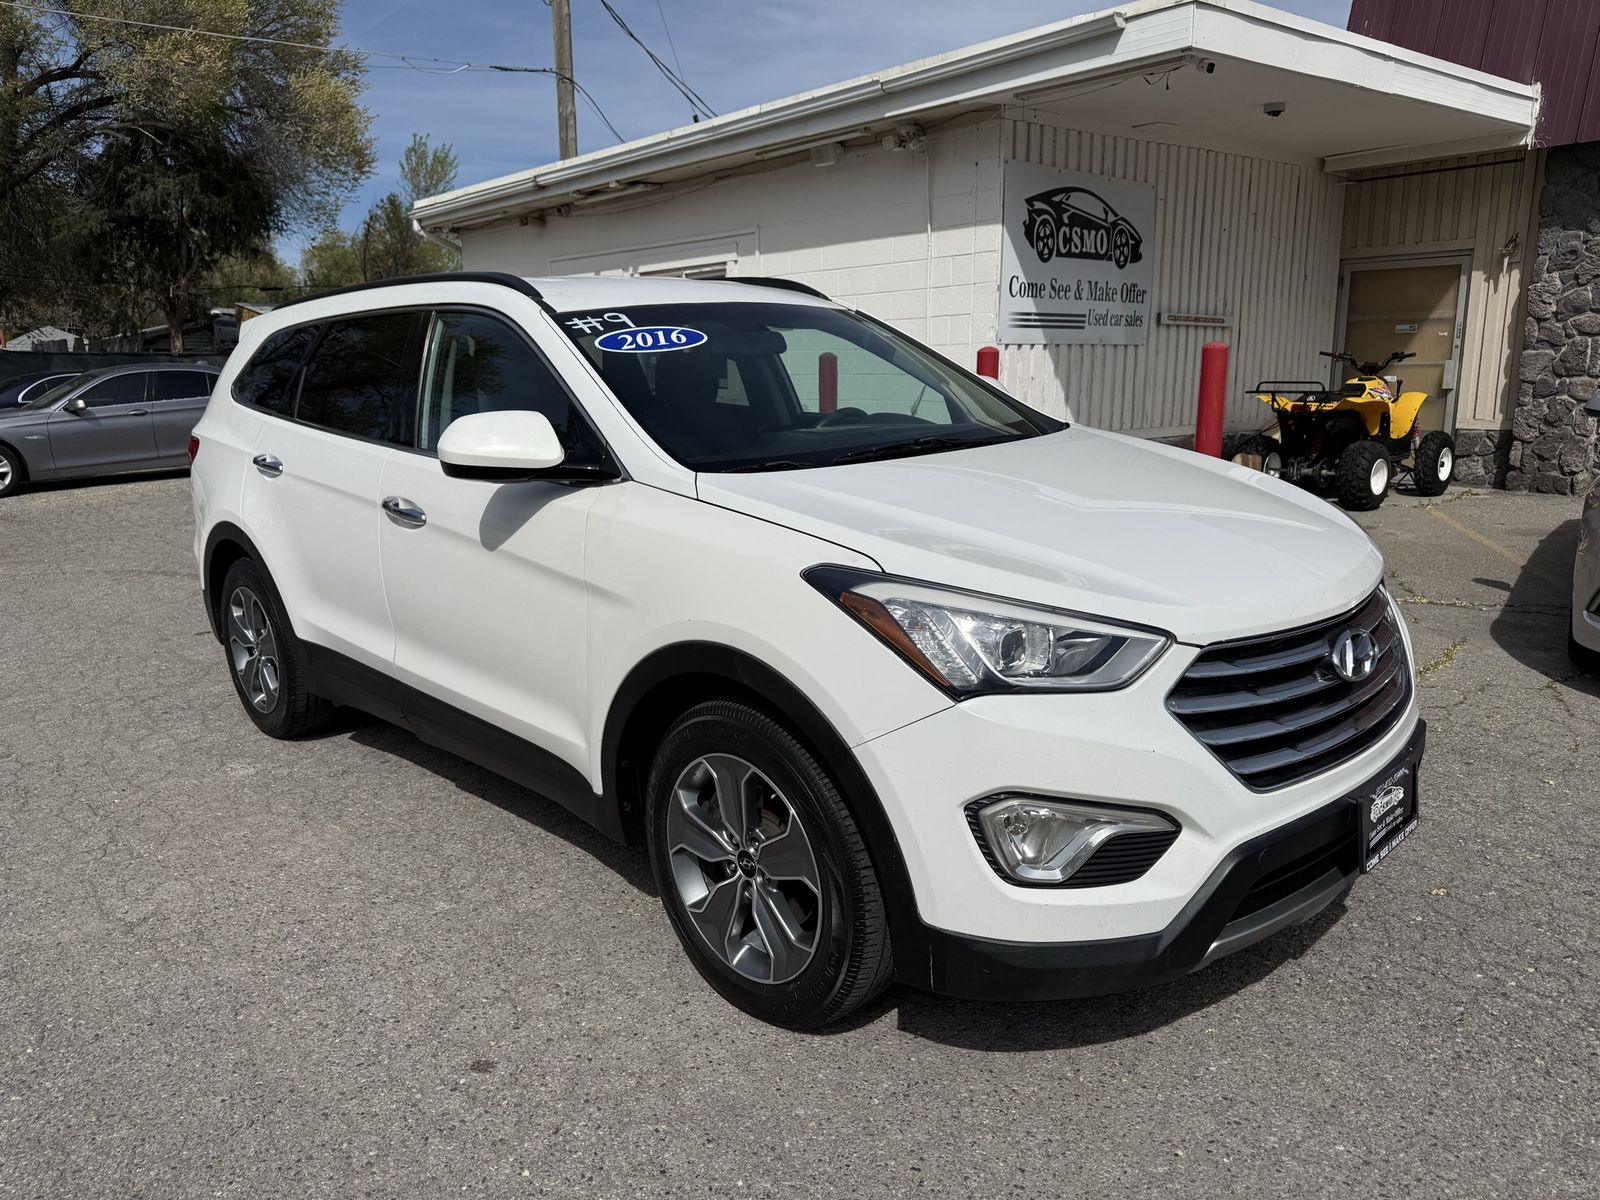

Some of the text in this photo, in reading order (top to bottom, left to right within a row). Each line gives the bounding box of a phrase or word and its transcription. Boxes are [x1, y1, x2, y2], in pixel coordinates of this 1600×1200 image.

[1058, 226, 1108, 255] CSMO
[1009, 275, 1147, 304] Come See & Make Offer
[565, 312, 636, 334] #9
[1087, 309, 1143, 328] Used car sales
[617, 329, 688, 351] 2016
